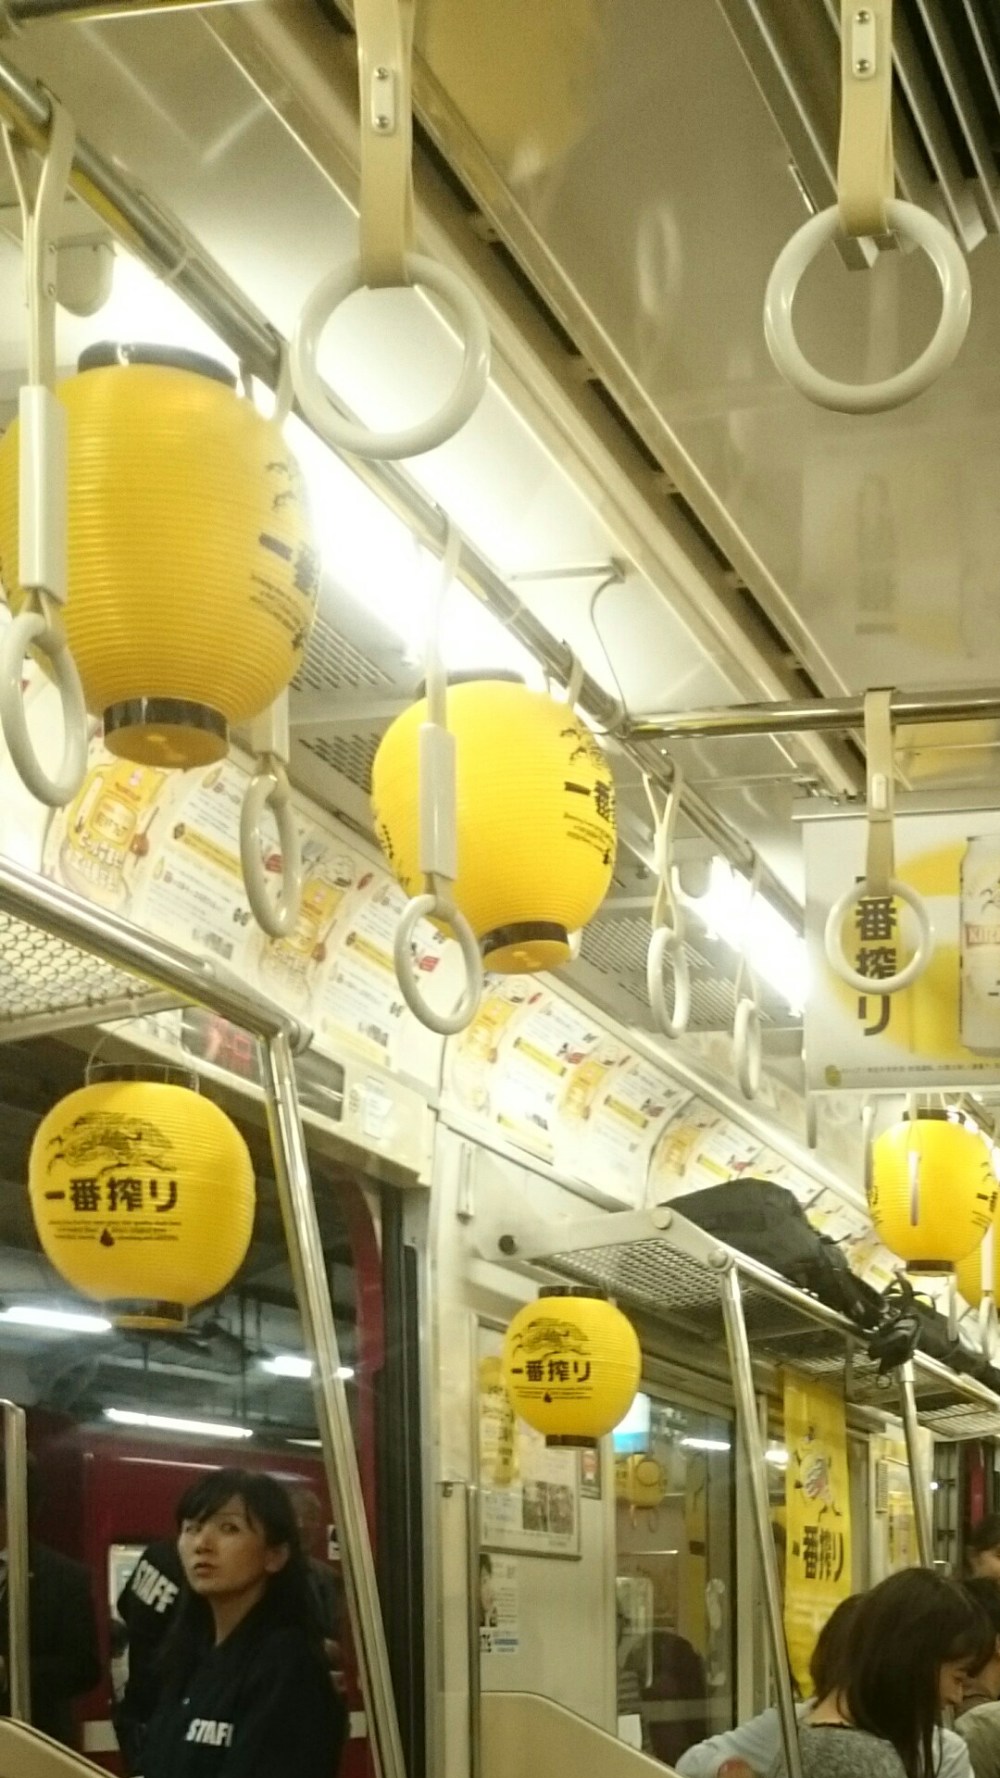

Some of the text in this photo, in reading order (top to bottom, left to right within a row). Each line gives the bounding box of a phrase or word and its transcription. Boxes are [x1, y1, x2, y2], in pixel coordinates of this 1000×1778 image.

[855, 876, 897, 1036] 番搾り
[44, 1176, 178, 1213] 一番搾り
[511, 1360, 591, 1383] 一番搾り
[132, 1559, 180, 1614] STAFF
